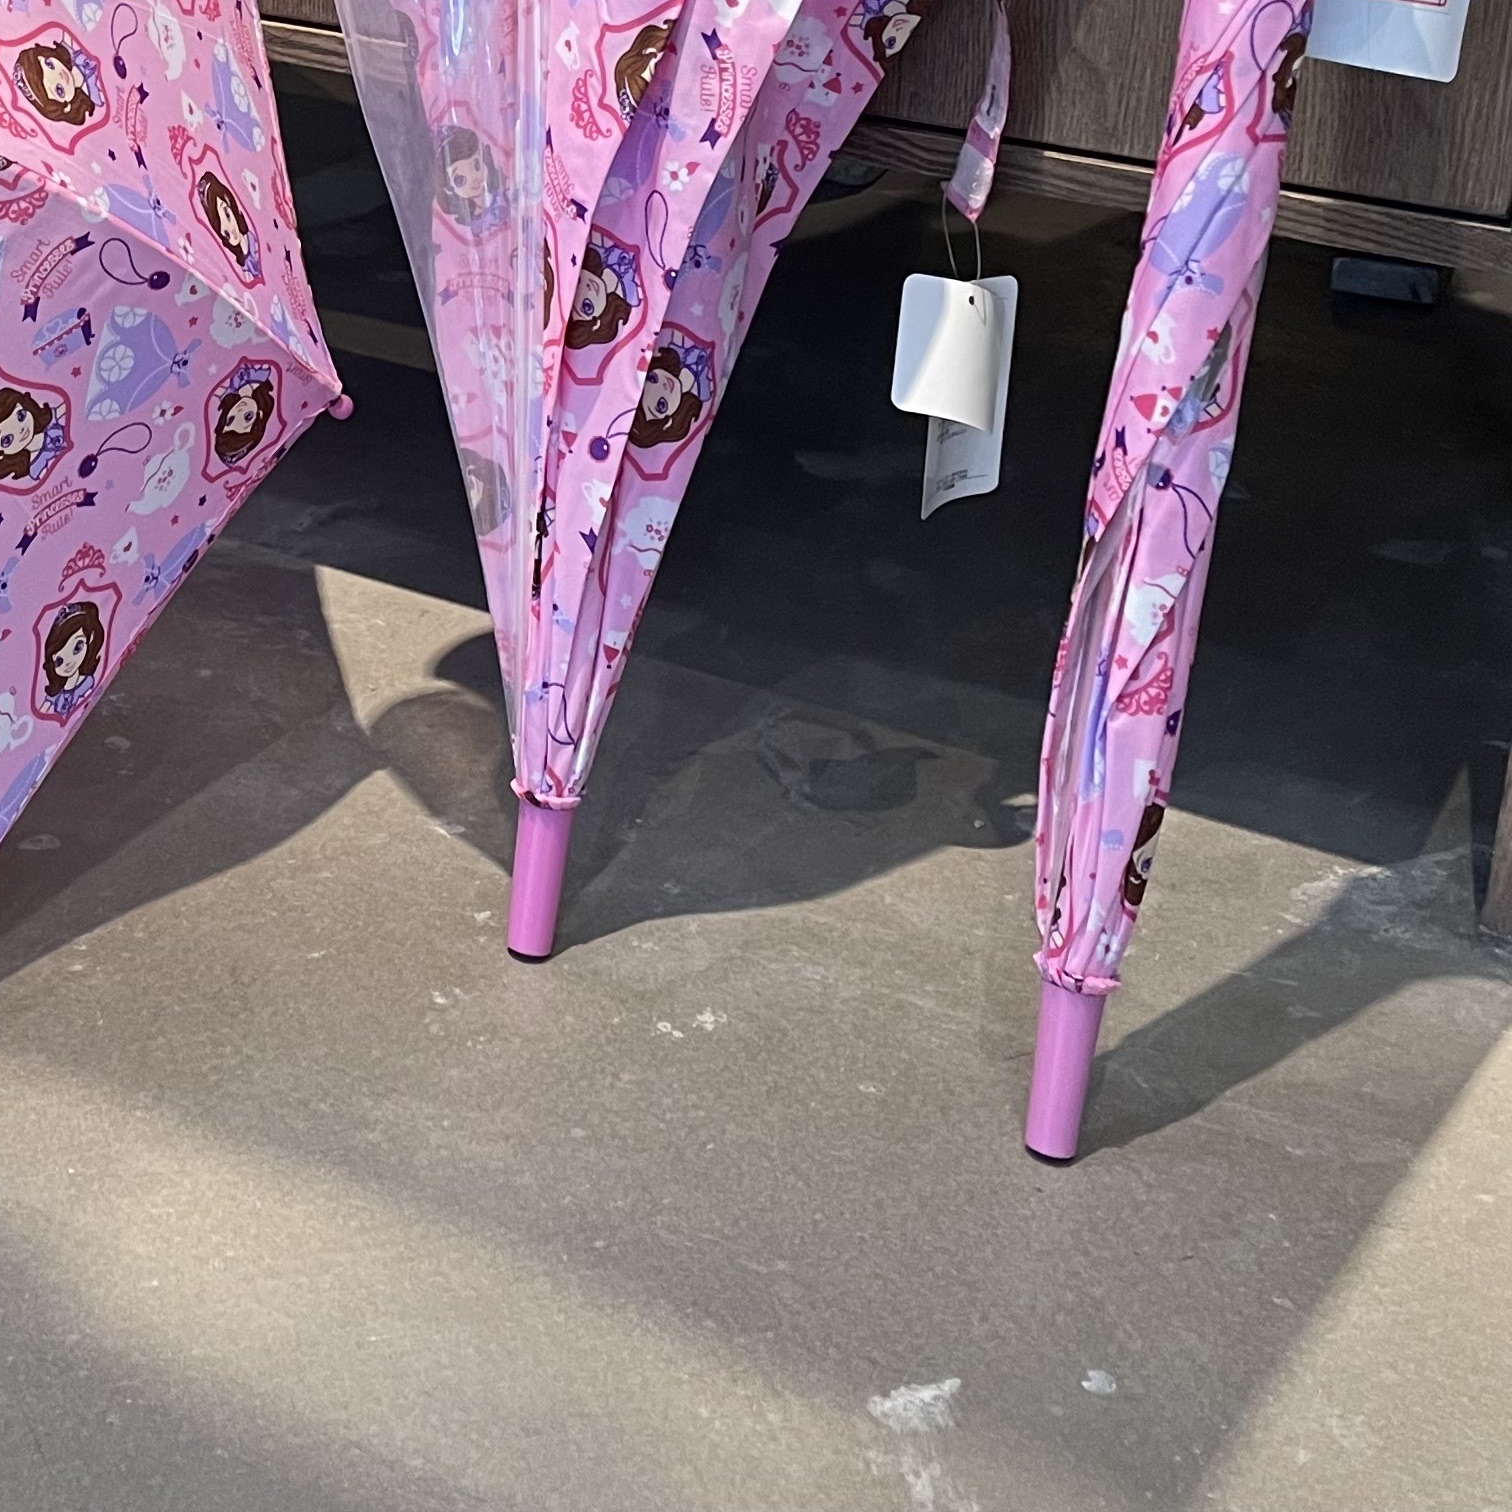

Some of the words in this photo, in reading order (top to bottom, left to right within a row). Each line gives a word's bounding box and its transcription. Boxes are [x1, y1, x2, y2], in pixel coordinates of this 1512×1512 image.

[700, 64, 716, 113] Rule!
[715, 47, 735, 135] Princesses
[11, 239, 50, 283] Smart
[21, 238, 76, 304] Princesses
[42, 259, 74, 299] Rule!
[31, 475, 73, 509] Smart
[41, 508, 74, 539] Rule!
